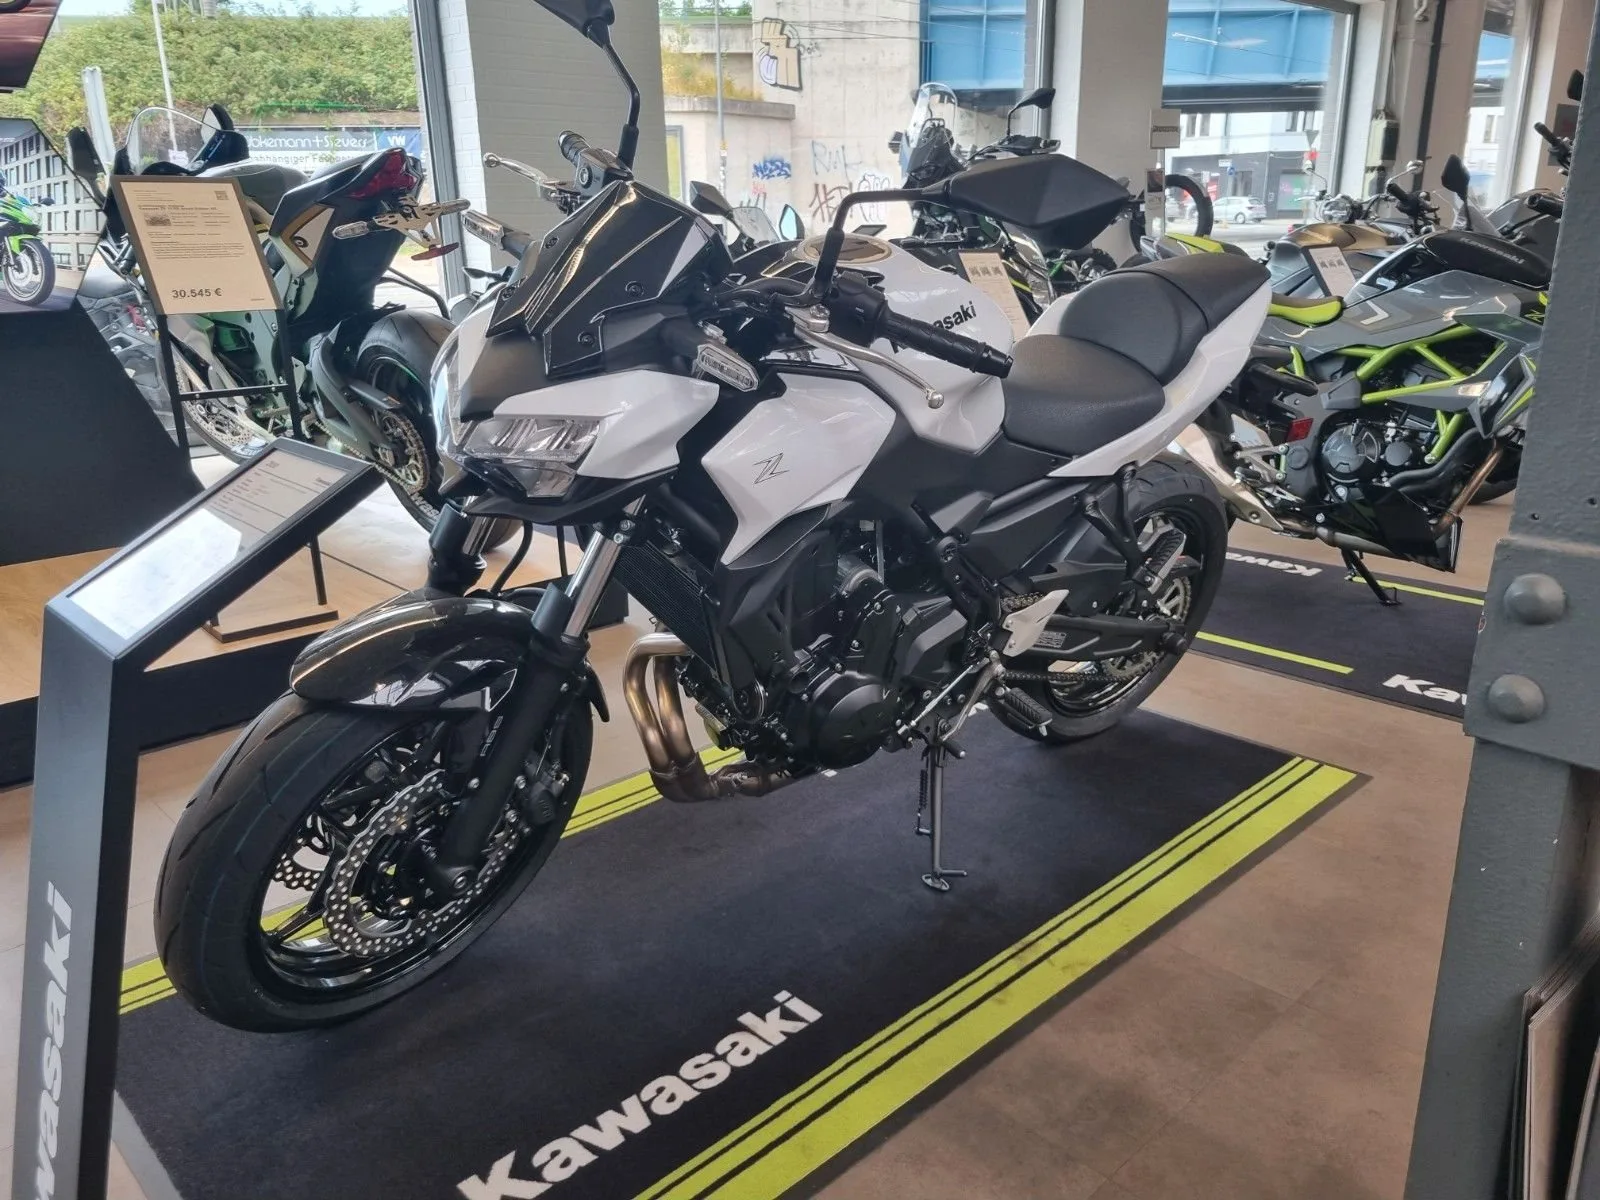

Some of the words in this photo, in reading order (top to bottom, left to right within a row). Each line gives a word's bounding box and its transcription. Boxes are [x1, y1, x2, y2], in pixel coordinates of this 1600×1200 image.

[386, 135, 406, 146] VW
[171, 288, 212, 299] 30.545
[214, 287, 224, 298] €
[932, 300, 977, 330] asaki
[1225, 551, 1323, 577] Kawa
[35, 880, 73, 1200] wasaki
[456, 989, 824, 1200] Kawasaki
